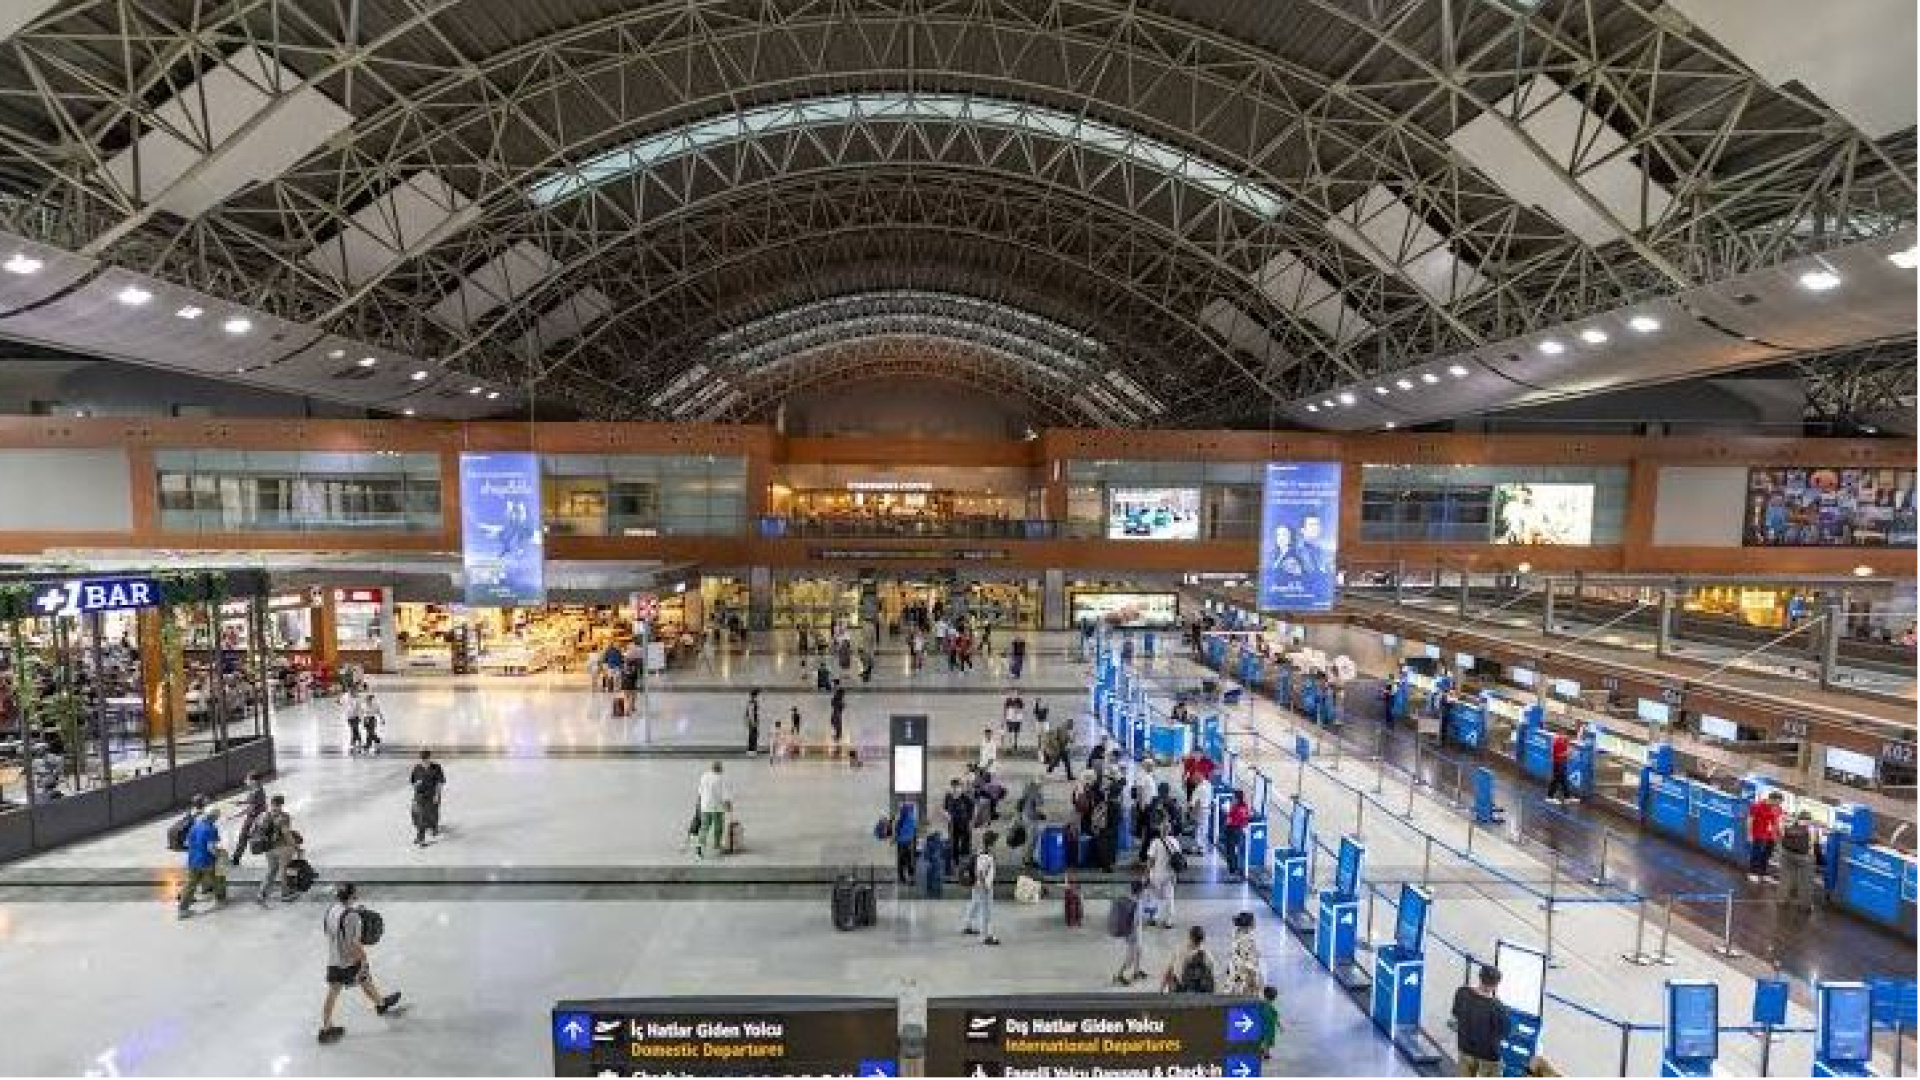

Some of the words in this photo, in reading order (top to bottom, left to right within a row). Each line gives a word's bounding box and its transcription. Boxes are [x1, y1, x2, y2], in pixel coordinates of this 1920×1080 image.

[85, 583, 150, 608] BAR
[648, 1021, 693, 1038] Hatlar
[696, 1021, 740, 1038] Giden
[743, 1021, 783, 1037] Yolcu
[1006, 1018, 1028, 1036] Dış
[1033, 1018, 1078, 1033] Hatlar
[1081, 1018, 1124, 1033] Giden
[1126, 1016, 1164, 1033] Yolcu
[631, 1043, 699, 1057] Domestic
[703, 1043, 784, 1060] Departures
[1006, 1038, 1100, 1052] International
[1103, 1038, 1181, 1056] Departures
